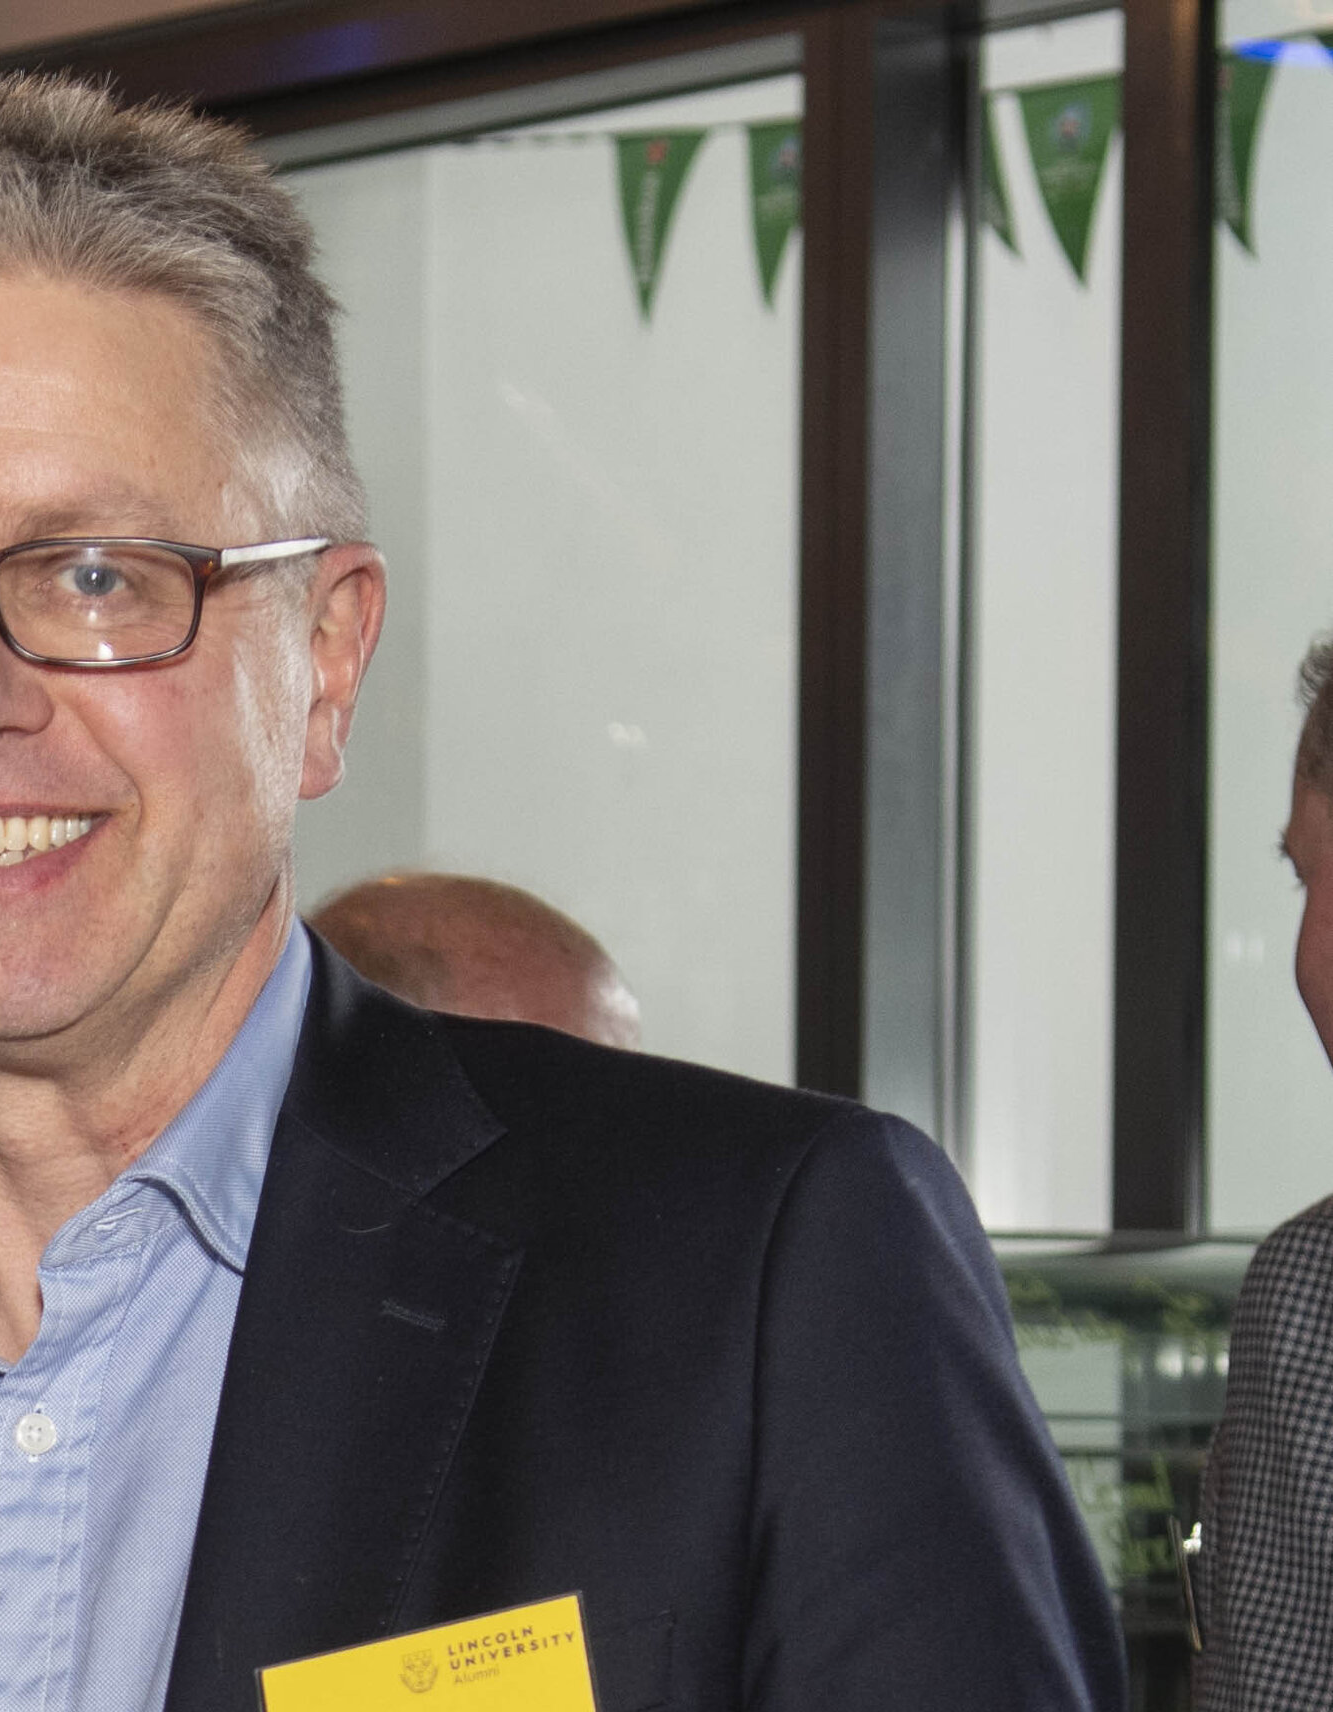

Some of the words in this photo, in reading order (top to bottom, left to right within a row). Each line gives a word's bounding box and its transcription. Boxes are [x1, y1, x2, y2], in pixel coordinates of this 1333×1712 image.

[447, 1625, 534, 1656] LINCOLN
[449, 1631, 575, 1670] UNIVERSITY
[453, 1665, 501, 1686] Alumni
